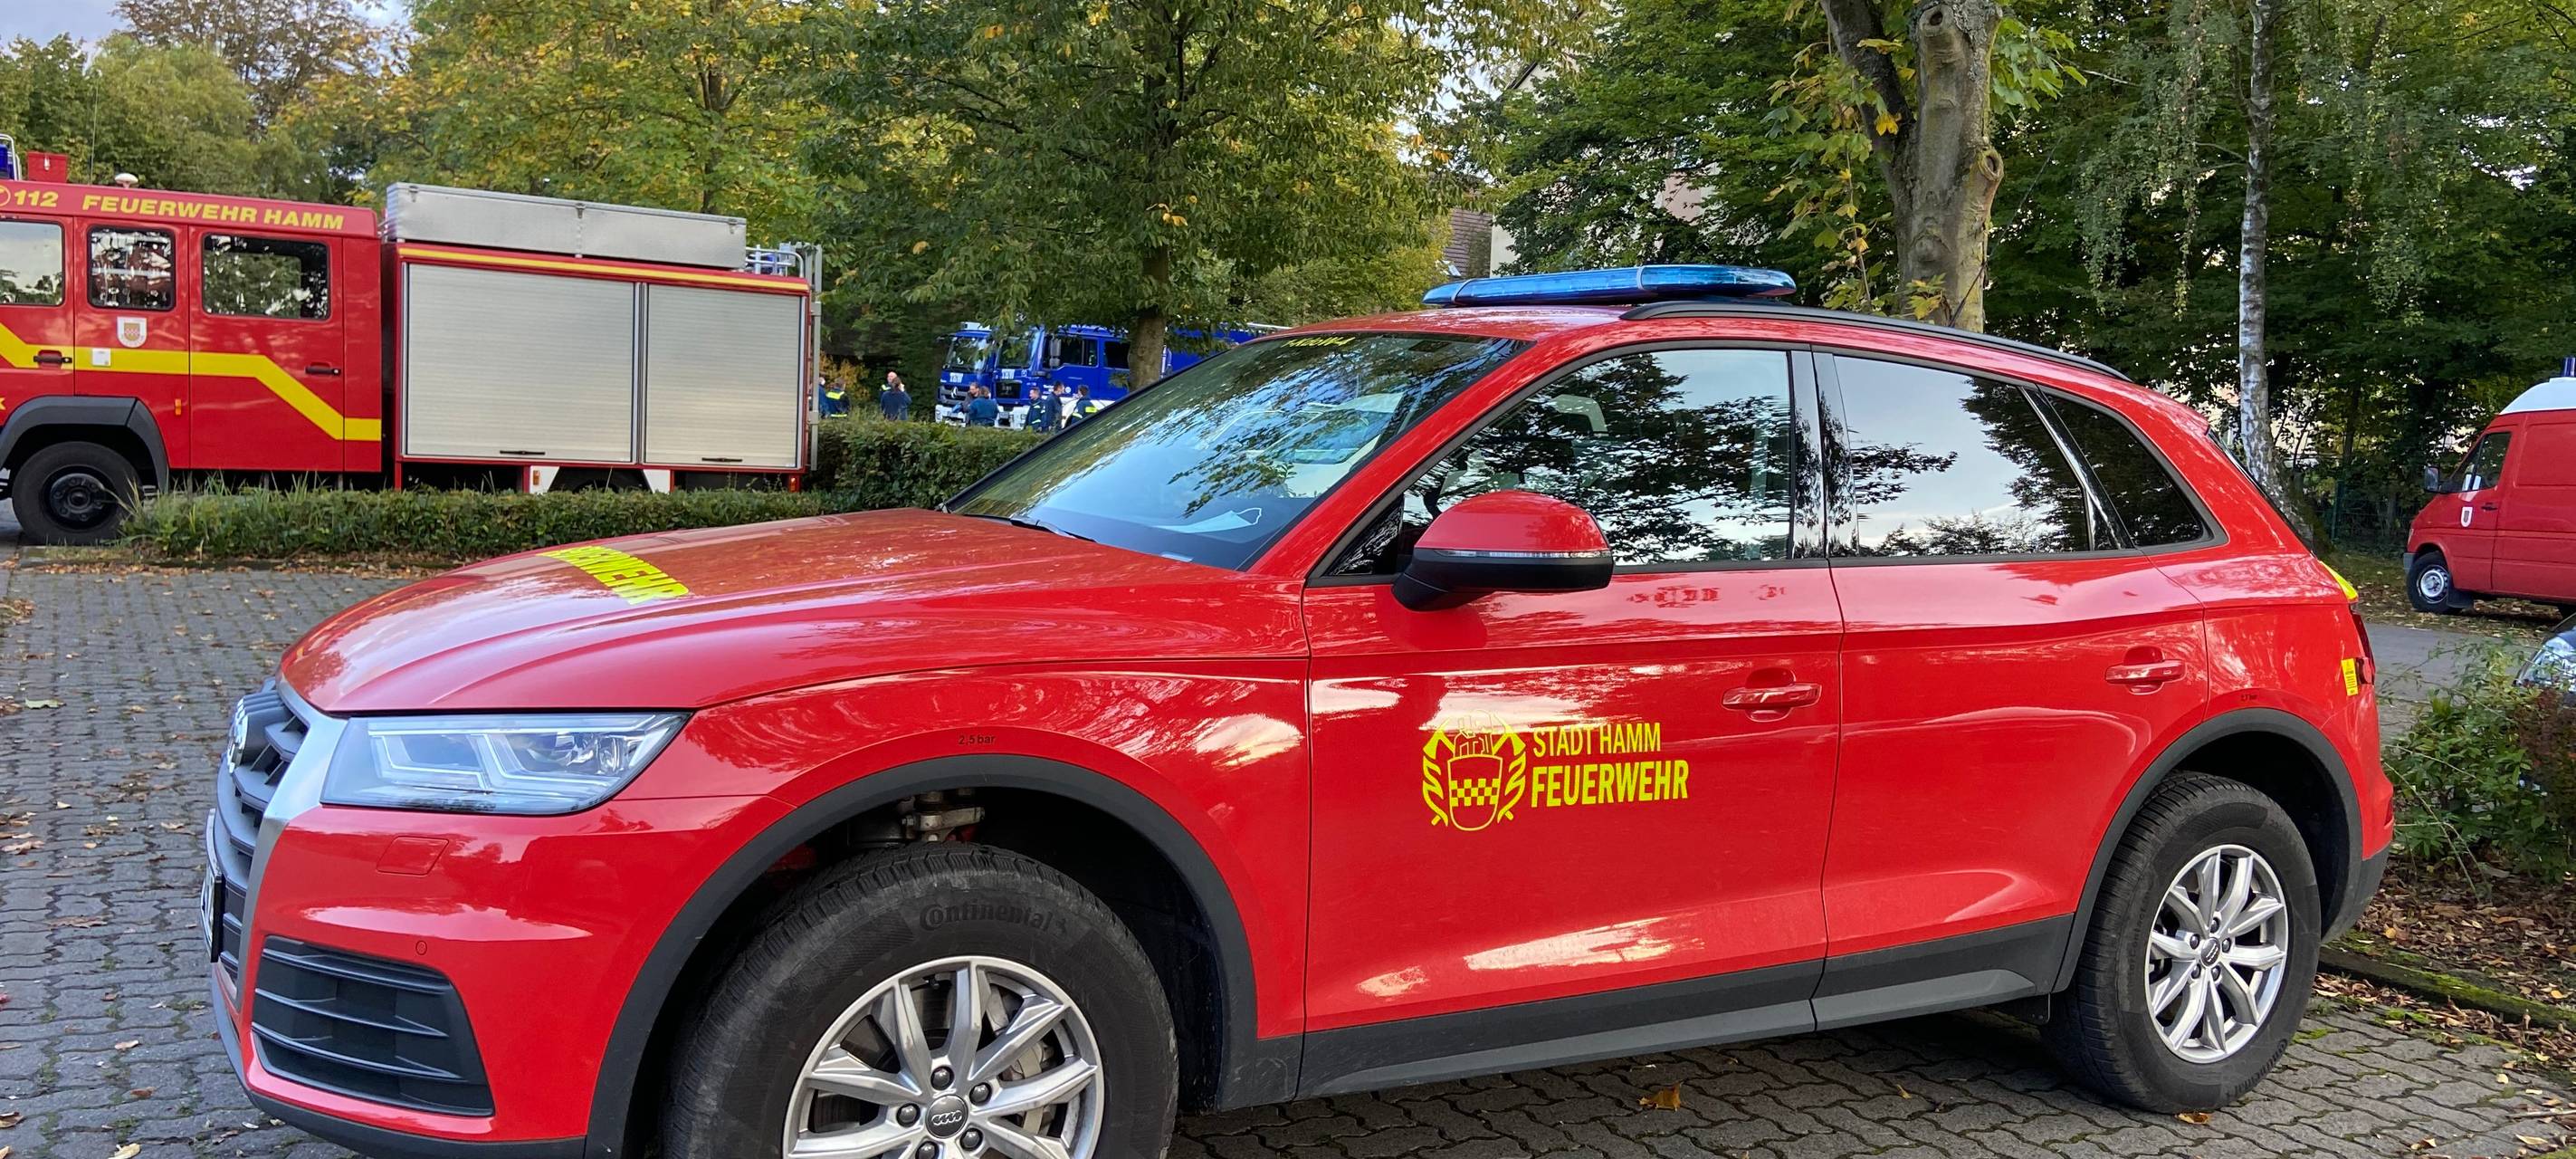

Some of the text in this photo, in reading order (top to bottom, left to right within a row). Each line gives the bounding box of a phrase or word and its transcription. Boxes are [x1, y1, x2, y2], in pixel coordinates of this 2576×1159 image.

[14, 188, 344, 231] 112 FEUERWEHR HAMM
[978, 733, 995, 743] bar
[1532, 722, 1662, 758] STADT HAMM
[1530, 760, 1690, 809] FEUERWEHR
[919, 899, 1054, 932] Continental
